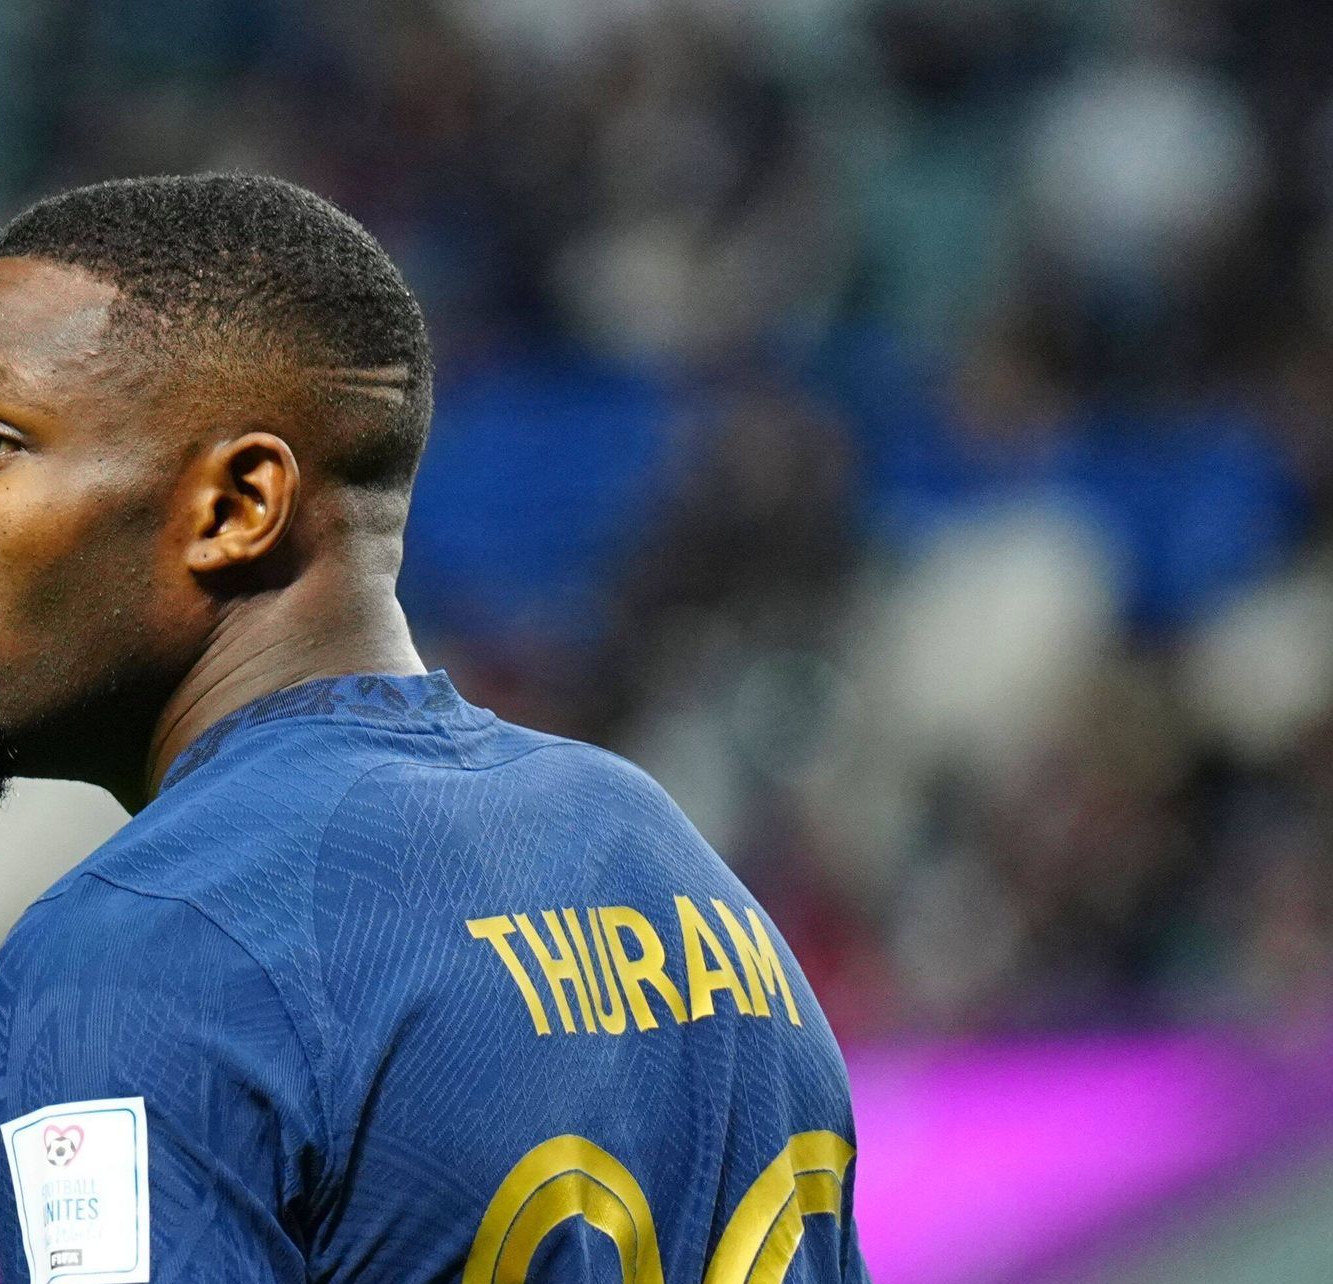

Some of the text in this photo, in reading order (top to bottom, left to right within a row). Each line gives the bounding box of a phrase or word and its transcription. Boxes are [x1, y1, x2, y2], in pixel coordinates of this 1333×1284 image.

[465, 894, 802, 1036] THURAM
[41, 1178, 96, 1199] OTBALL
[43, 1197, 99, 1227] NITES
[51, 1252, 80, 1267] FIFA
